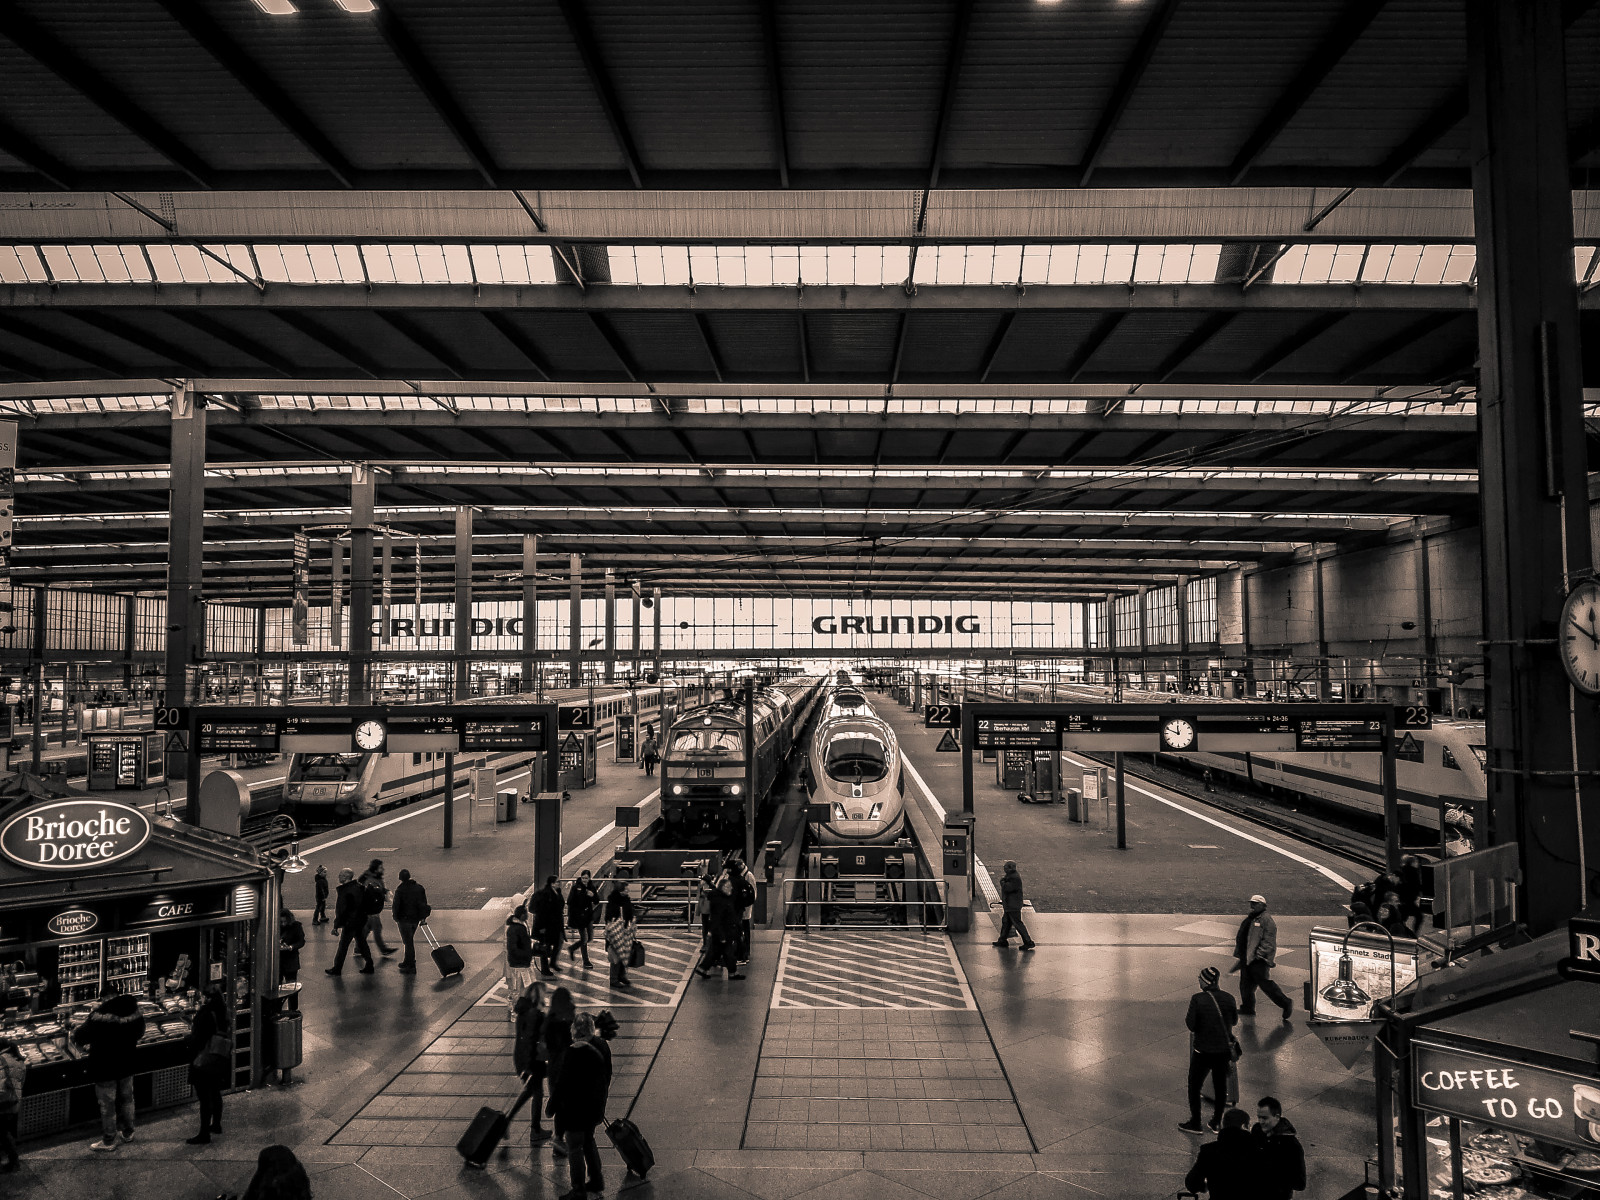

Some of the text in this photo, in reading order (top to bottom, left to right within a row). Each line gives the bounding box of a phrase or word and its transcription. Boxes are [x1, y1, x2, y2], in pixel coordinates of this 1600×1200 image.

[812, 614, 981, 634] GRUNDIG
[157, 709, 180, 725] 20
[572, 707, 591, 725] 21
[929, 706, 951, 723] 22
[1406, 707, 1429, 725] 23
[201, 723, 212, 733] 20
[531, 721, 541, 731] 21
[978, 720, 989, 729] 22
[1369, 721, 1380, 730] 23
[25, 809, 131, 841] Brioche
[38, 836, 114, 863] Dorée
[56, 912, 91, 926] Brioche
[1421, 1069, 1520, 1090] COFFEE
[1482, 1098, 1563, 1118] TO GO
